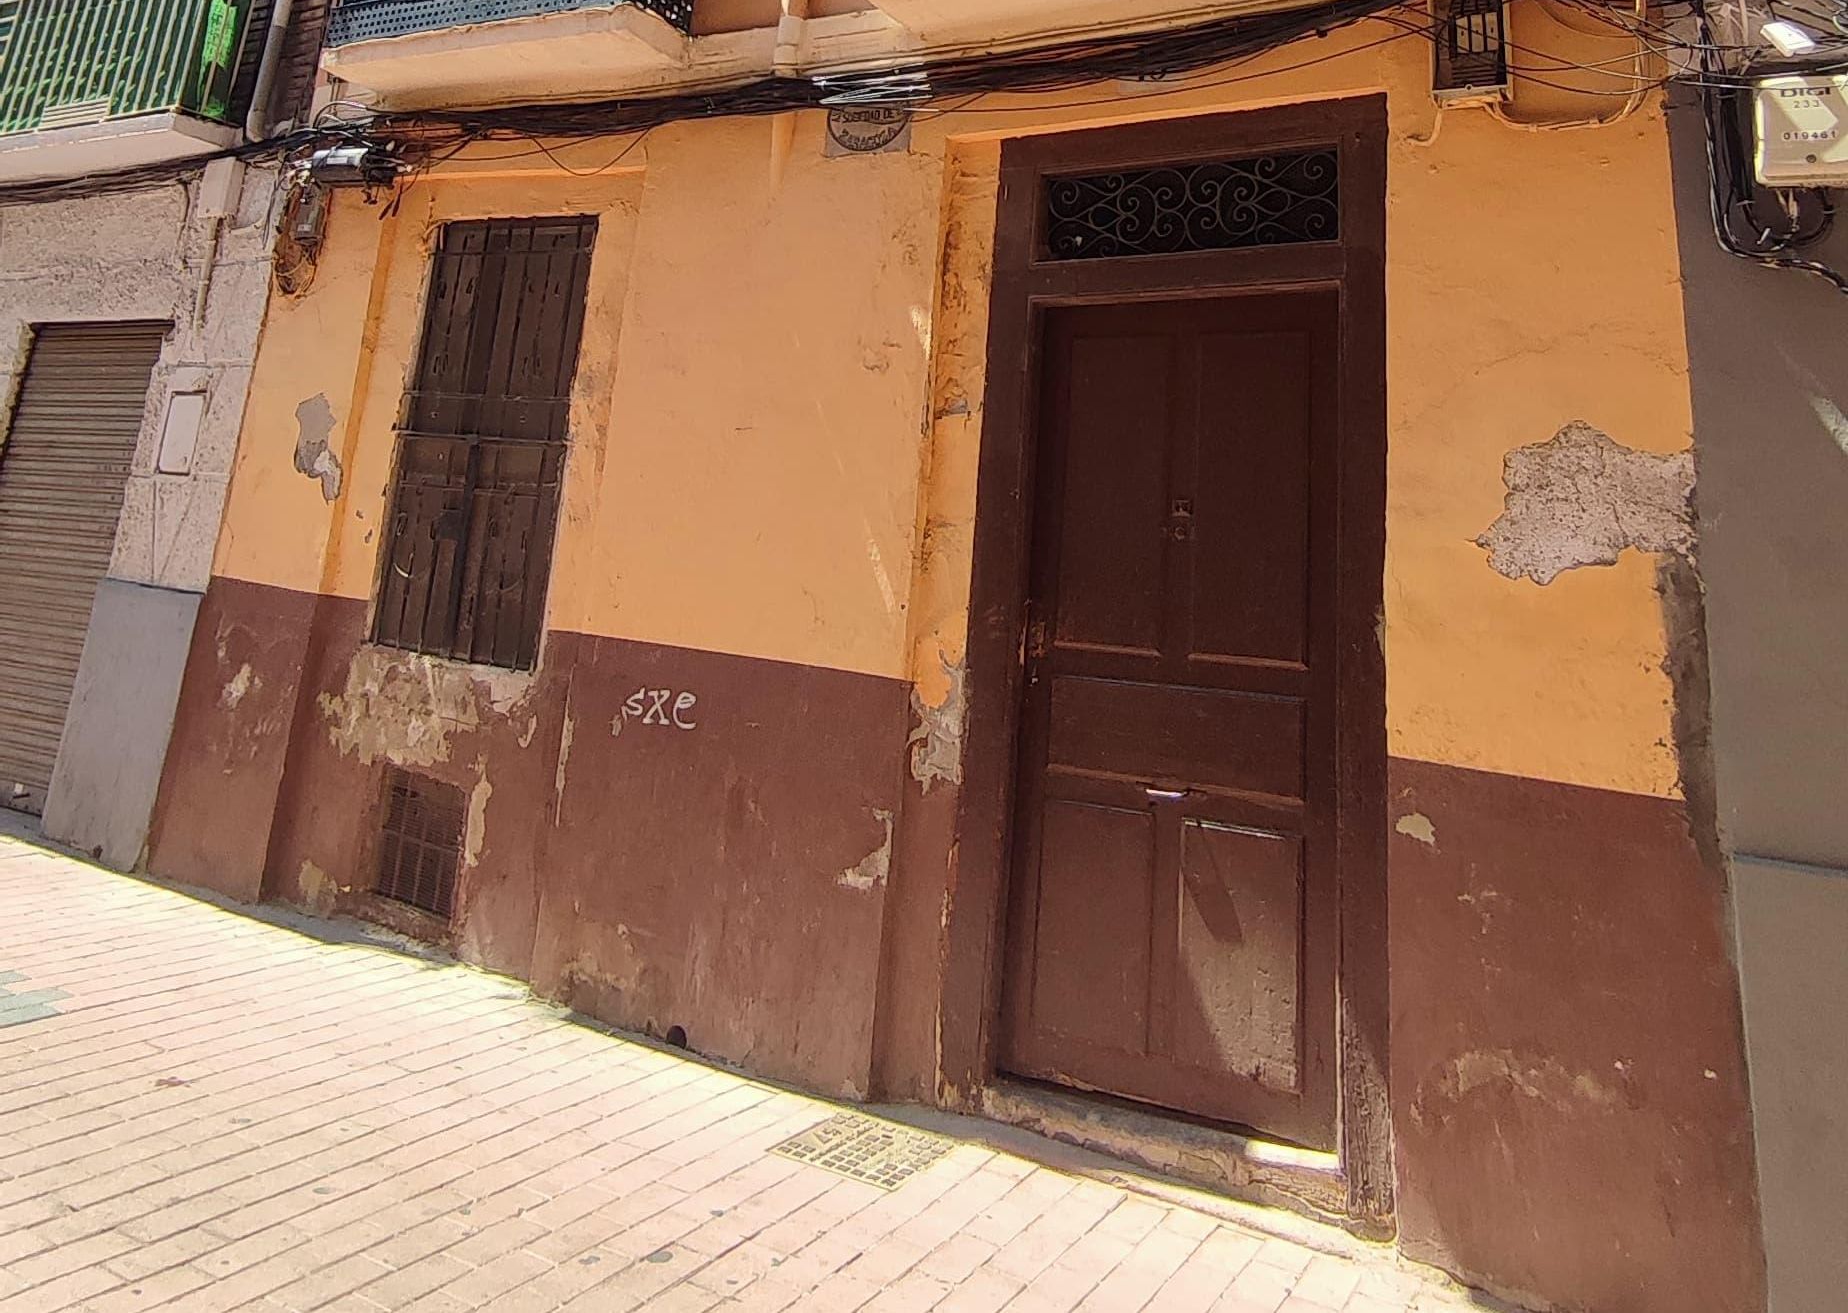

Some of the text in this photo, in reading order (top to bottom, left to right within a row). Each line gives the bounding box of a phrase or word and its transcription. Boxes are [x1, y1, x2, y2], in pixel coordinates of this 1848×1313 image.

[1780, 87, 1831, 97] DIGI
[1783, 130, 1837, 140] 019461
[622, 687, 697, 729] sxe
